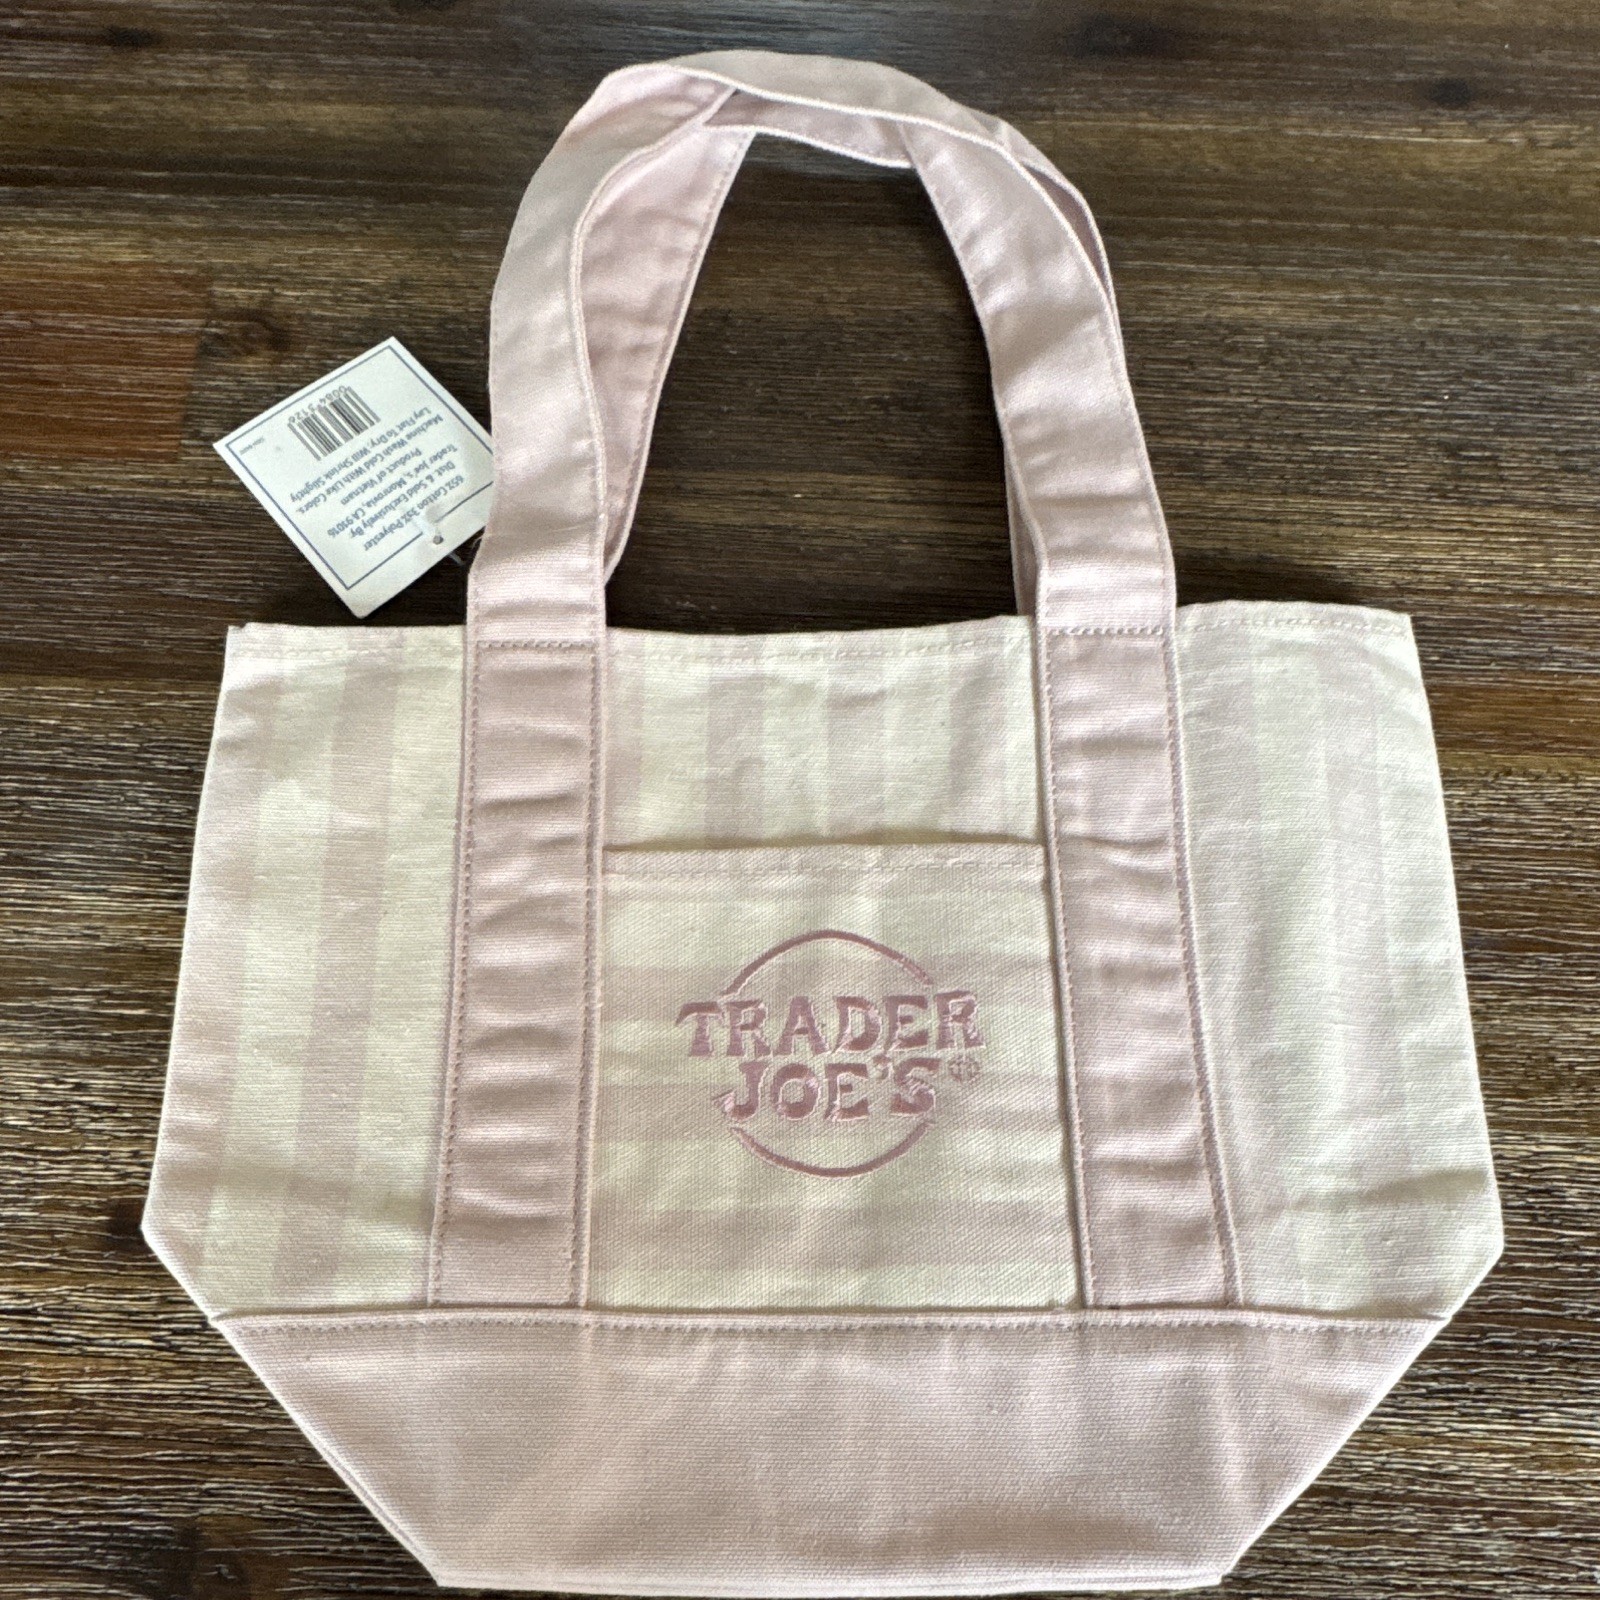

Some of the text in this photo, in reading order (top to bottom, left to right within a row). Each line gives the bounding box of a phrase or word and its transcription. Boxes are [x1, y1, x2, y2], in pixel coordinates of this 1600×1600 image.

[410, 404, 431, 421] Lay
[385, 428, 398, 440] To
[395, 416, 416, 432] Flat
[403, 413, 444, 442] Machine
[350, 446, 371, 462] Will
[381, 437, 408, 457] Wash
[427, 442, 458, 466] Trader
[322, 457, 354, 481] Shrink
[361, 452, 386, 471] Cold
[338, 446, 422, 507] Product of Vietnam
[341, 465, 366, 485] With
[424, 473, 435, 484] &
[444, 474, 465, 491] 65%
[287, 474, 326, 504] Slightly
[323, 479, 345, 498] Like
[360, 476, 407, 511] Monrovia,
[405, 479, 428, 498] Sold
[415, 485, 449, 512] Cotton
[350, 506, 366, 520] CA
[359, 492, 409, 530] Exclusively
[346, 523, 365, 540] By
[359, 516, 405, 552] Polyester
[675, 990, 986, 1057] TRADER
[711, 1054, 942, 1121] JOE'S
